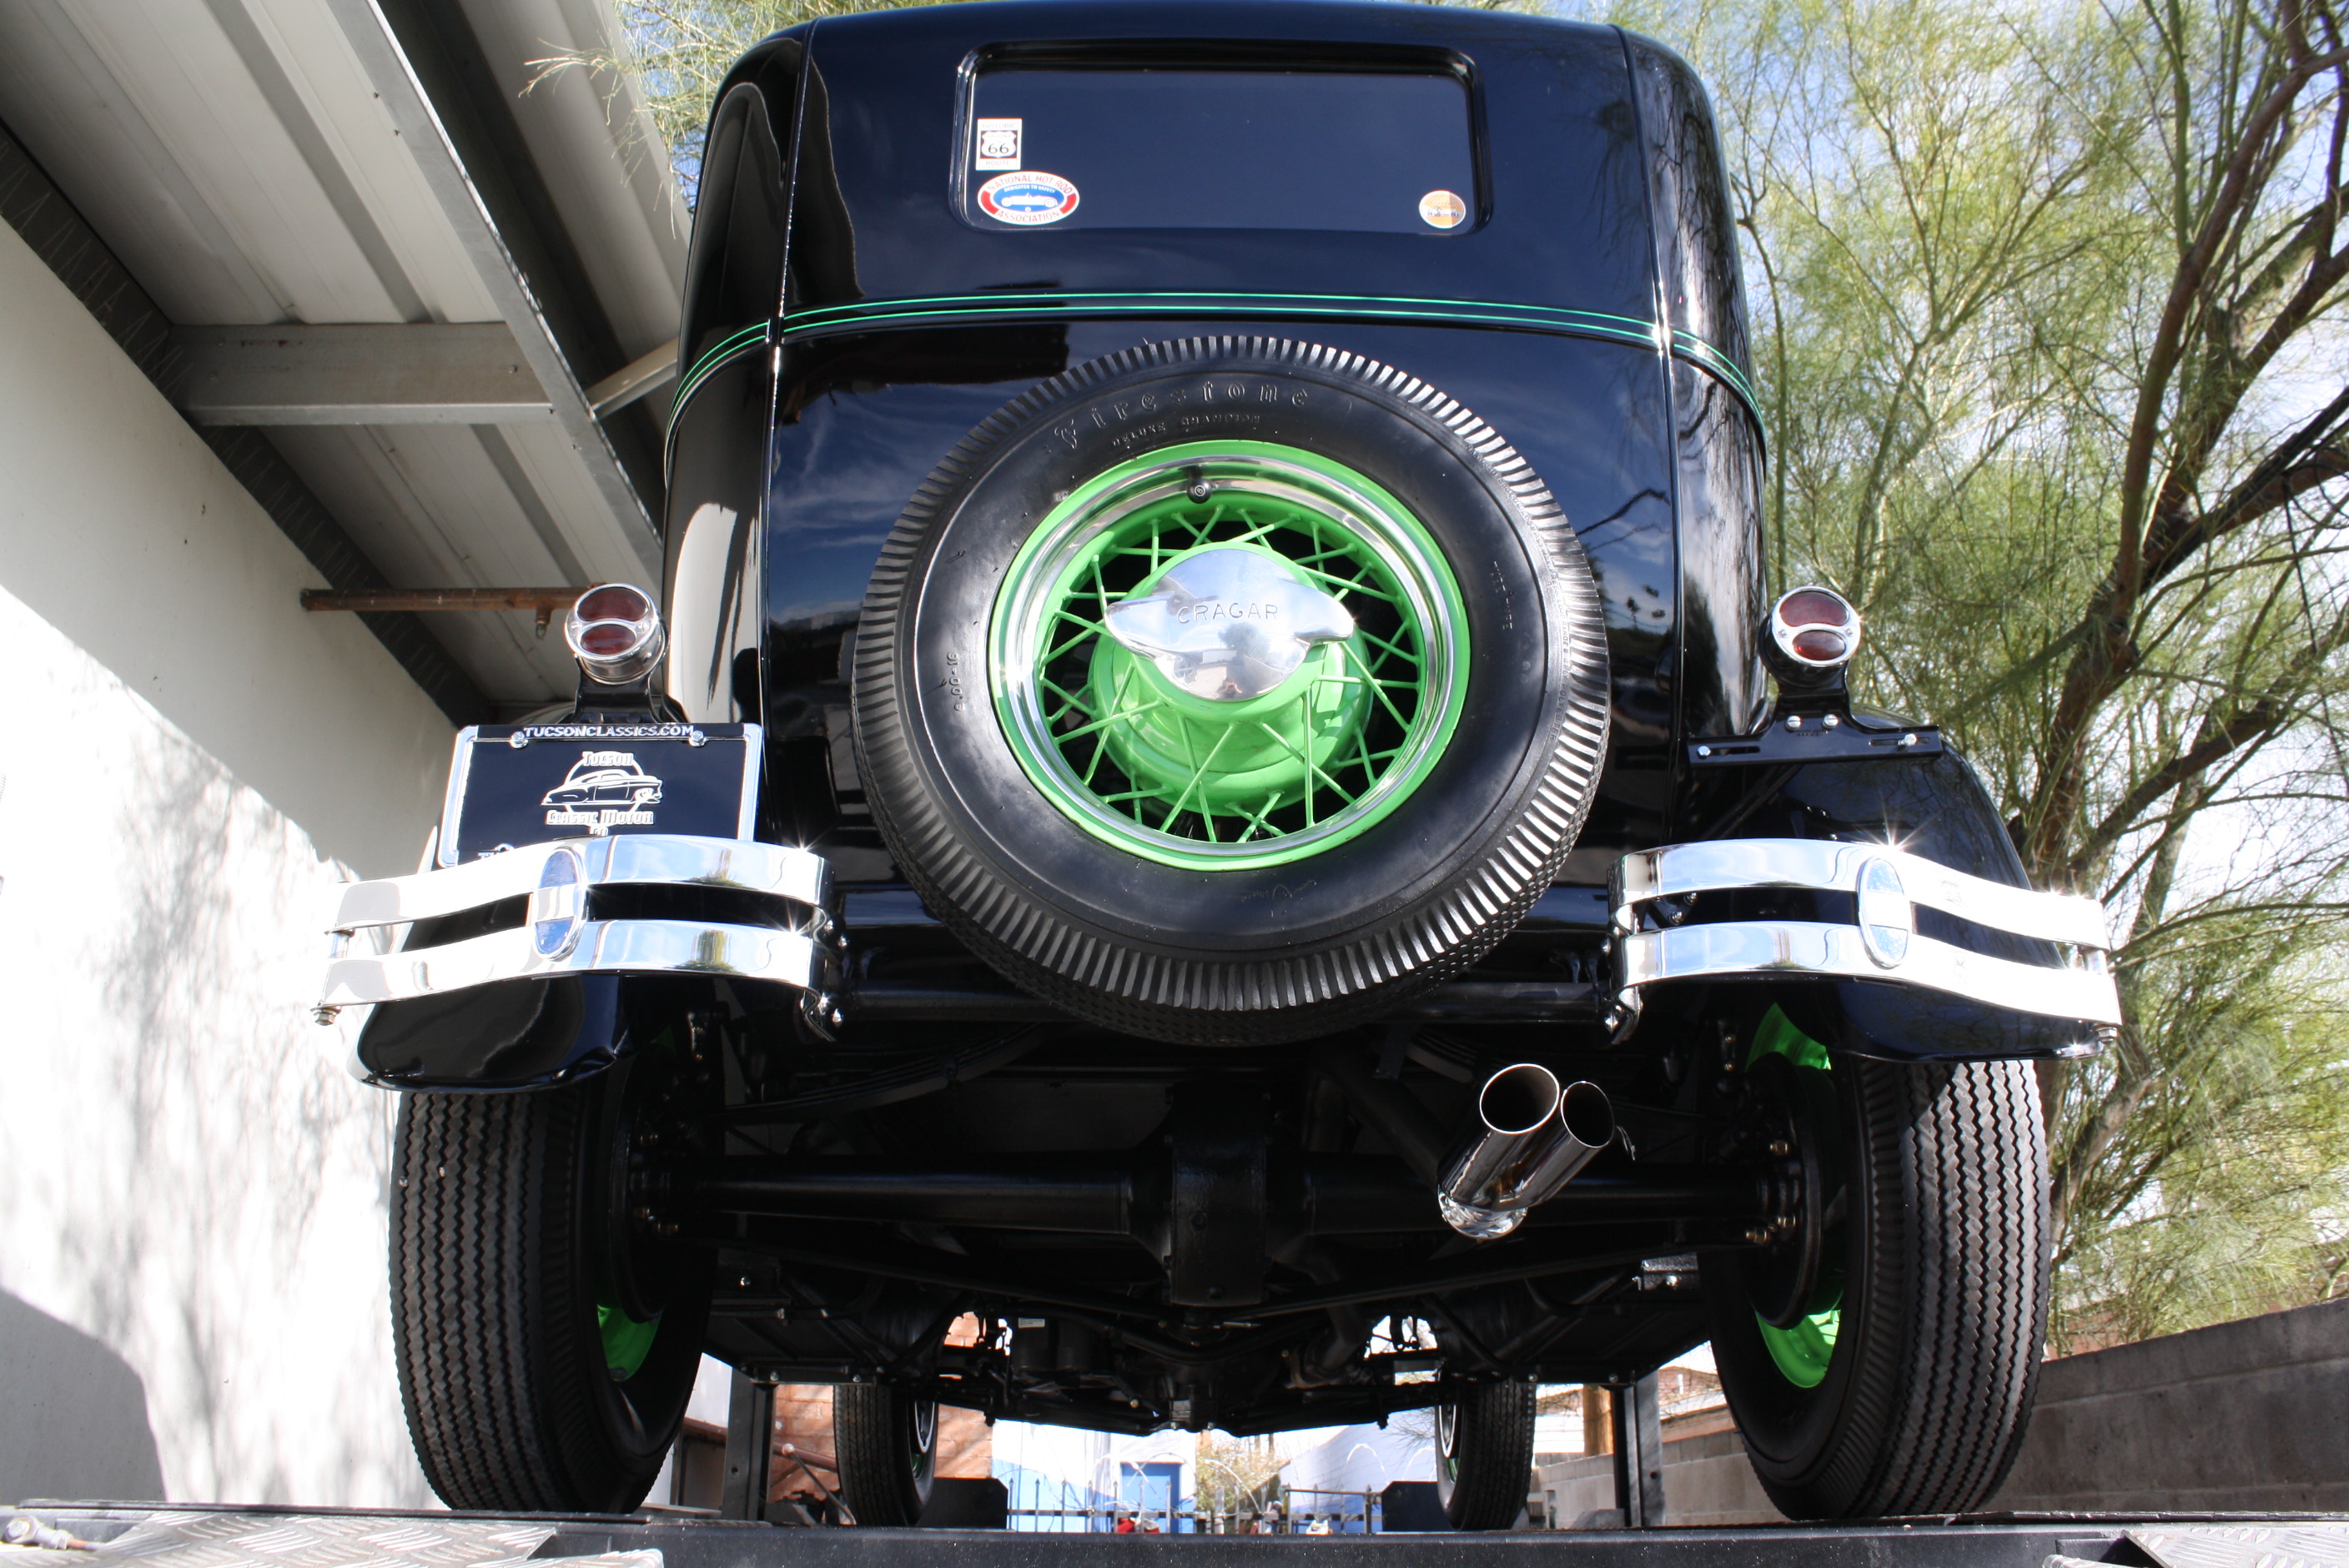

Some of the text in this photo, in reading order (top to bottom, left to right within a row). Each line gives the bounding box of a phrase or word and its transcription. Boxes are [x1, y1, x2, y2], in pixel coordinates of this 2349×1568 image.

[988, 143, 1009, 154] 66
[988, 174, 1073, 194] NATIONAL HOT ROD
[1003, 184, 1030, 193] DEDICATED
[1039, 185, 1057, 193] SAFETY
[998, 210, 1060, 224] ASSOCIATION
[1054, 380, 1309, 450] Firestone
[1176, 601, 1279, 624] CRAGAR
[1550, 683, 1567, 741] POLYESTER
[523, 725, 694, 737] TUCSONCLASSICS.COM
